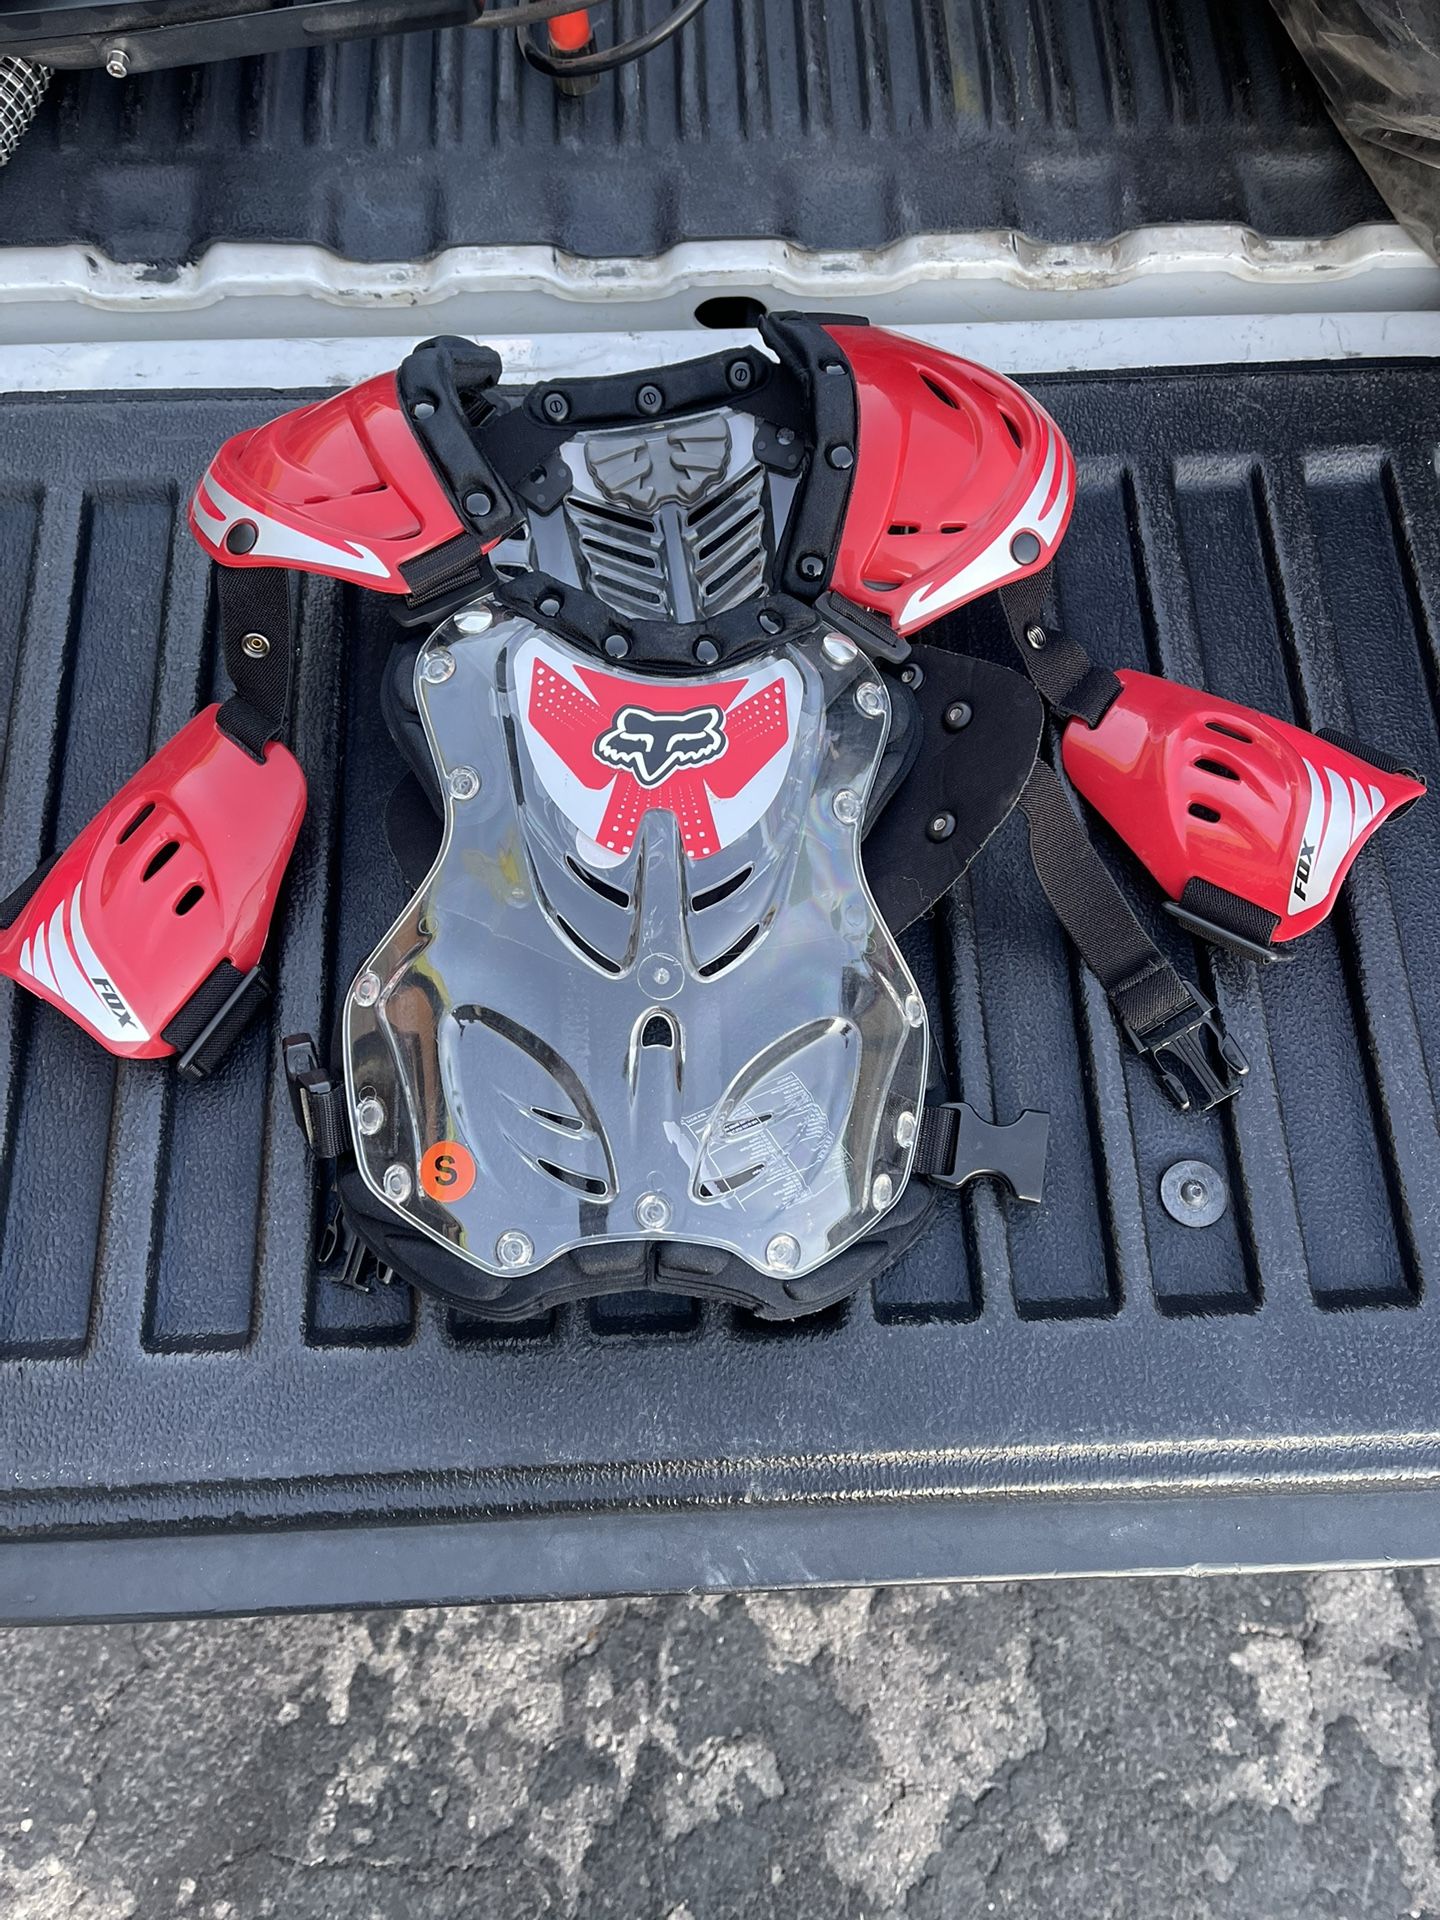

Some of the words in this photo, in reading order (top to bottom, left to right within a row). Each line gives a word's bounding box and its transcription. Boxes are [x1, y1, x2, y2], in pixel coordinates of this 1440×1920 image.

[1294, 837, 1315, 902] FOX
[91, 978, 138, 1029] FOX
[434, 1155, 458, 1186] S
